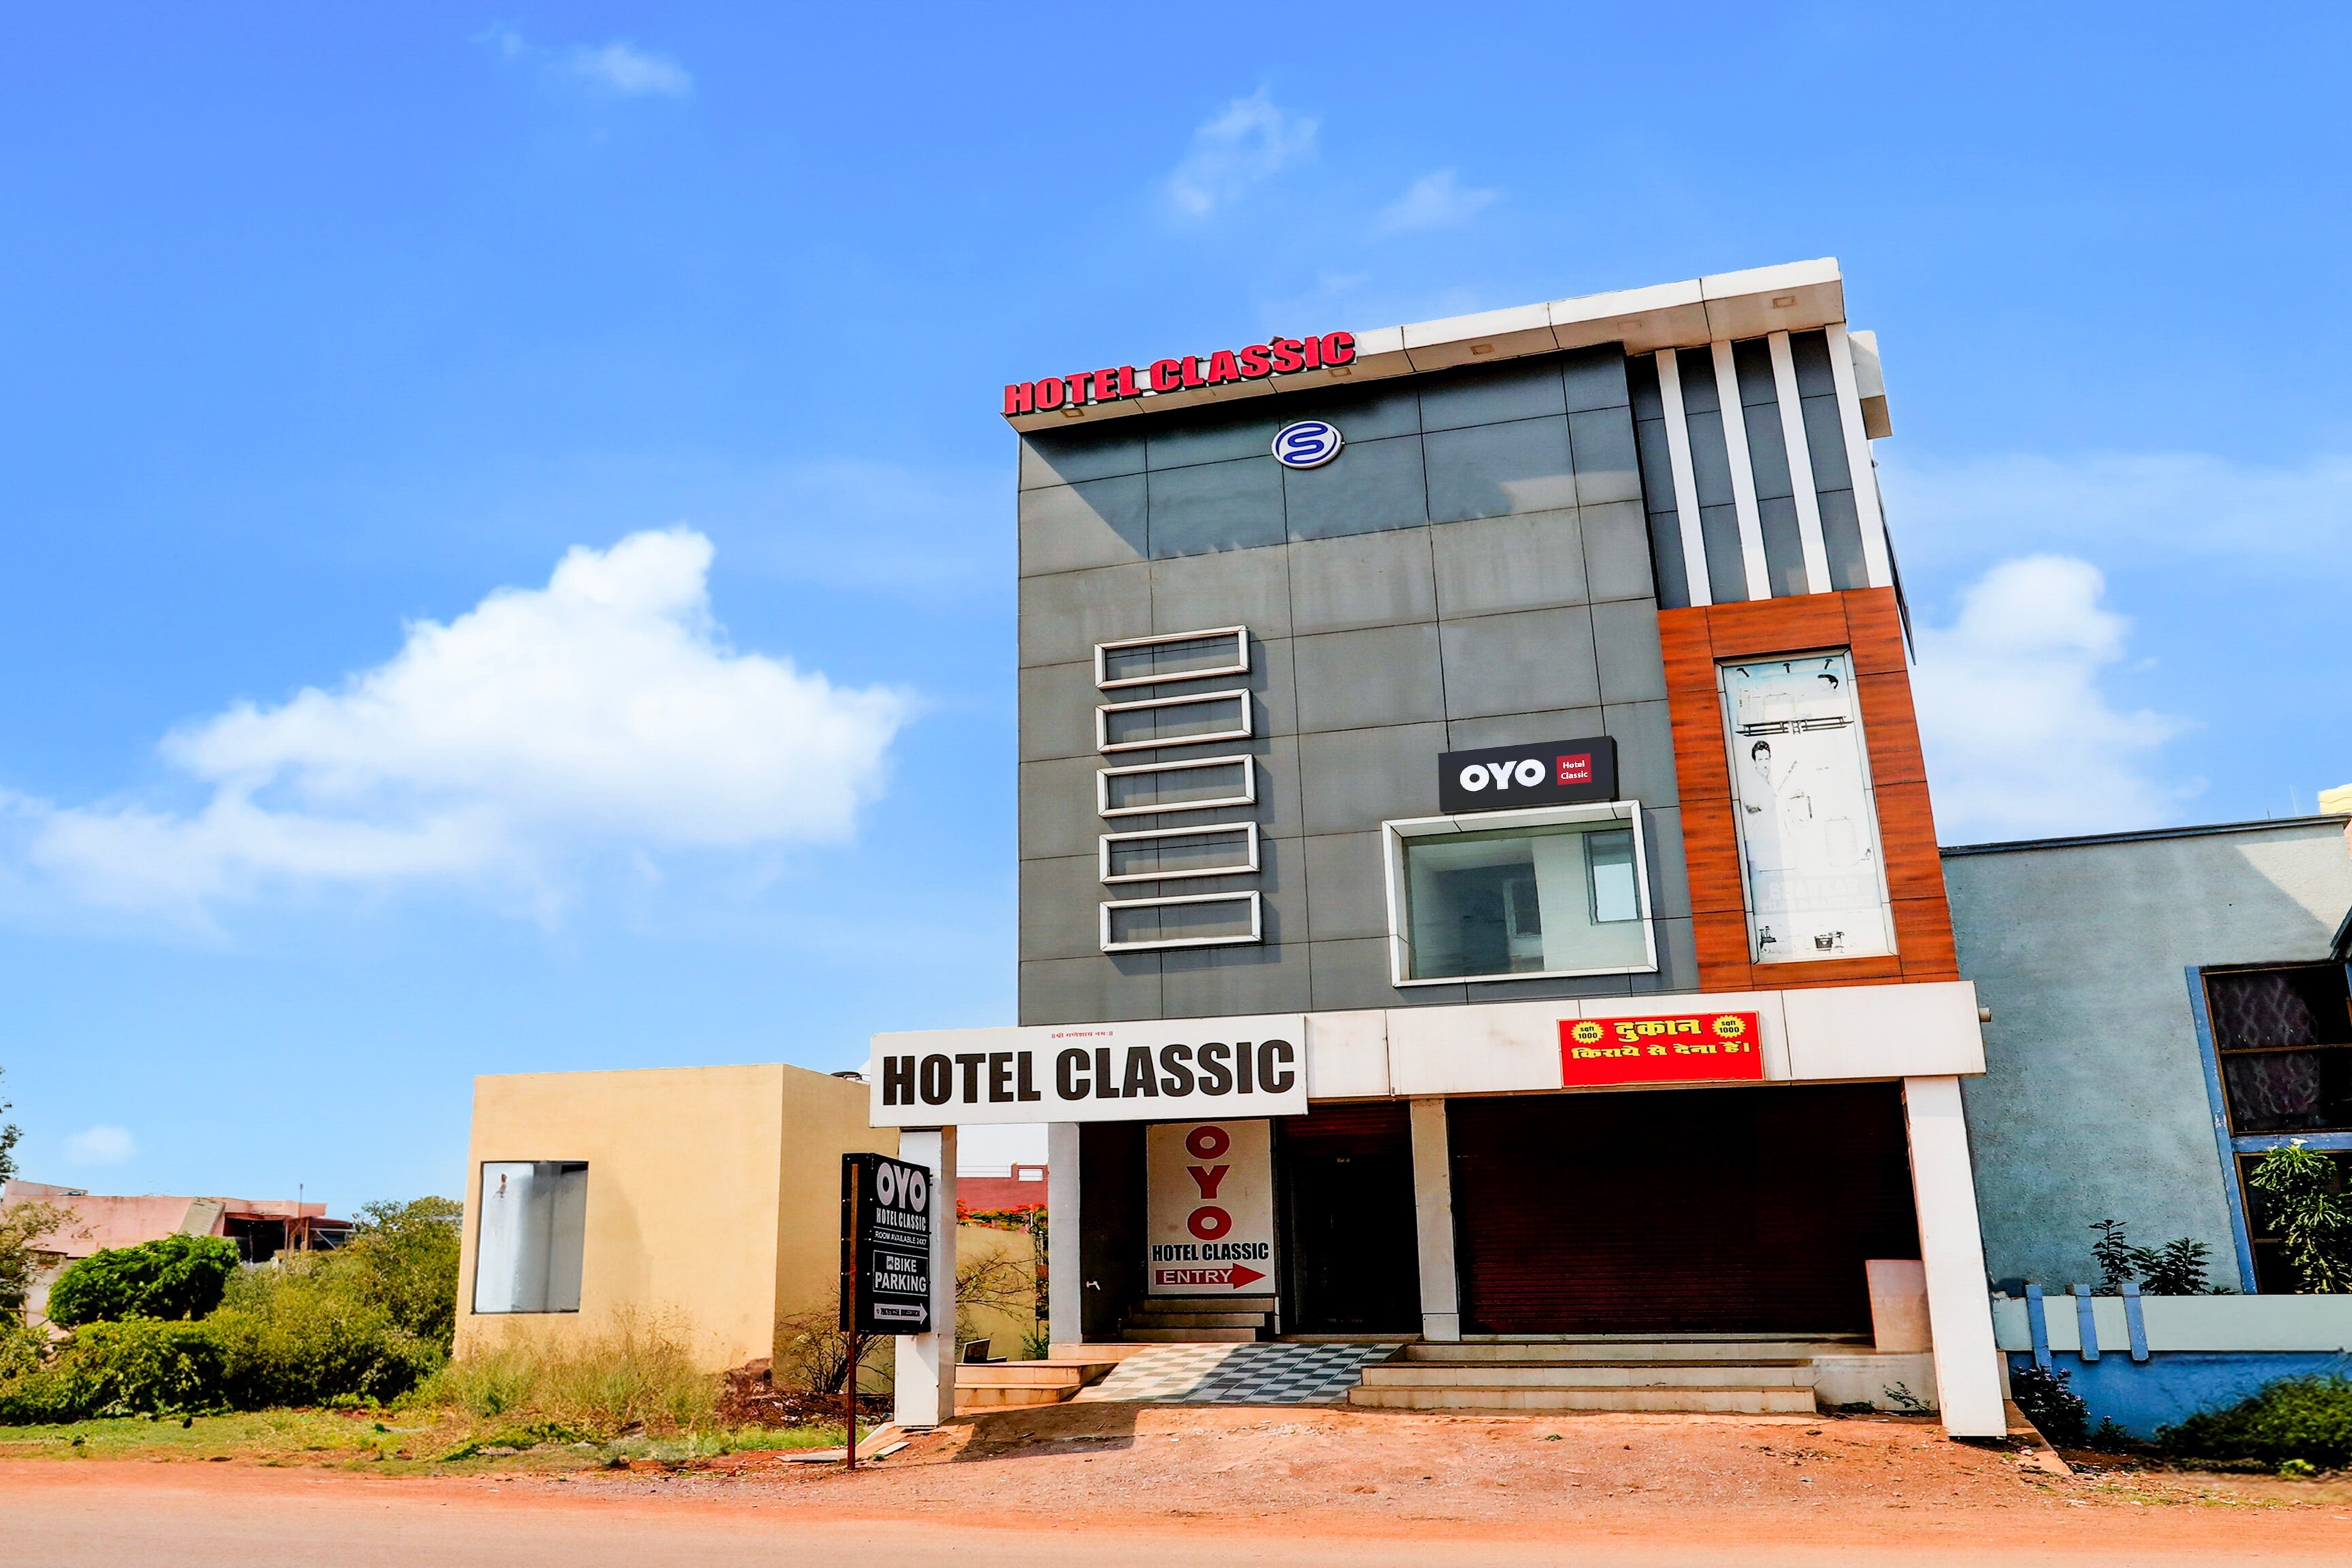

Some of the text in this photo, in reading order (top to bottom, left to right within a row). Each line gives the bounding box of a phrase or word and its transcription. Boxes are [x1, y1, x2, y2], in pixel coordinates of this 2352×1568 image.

[1004, 331, 1356, 415] HOTEL CLASSIC
[1561, 770, 1588, 779] Classic
[1563, 760, 1585, 769] Hotel
[1460, 759, 1546, 791] OYO
[1614, 1019, 1702, 1042] दुकान
[1571, 1045, 1641, 1059] किराये
[1646, 1044, 1667, 1056] से
[1673, 1043, 1718, 1054] देना
[883, 1039, 1294, 1106] HOTEL CLASSIC
[877, 1162, 926, 1212] OYO
[877, 1207, 926, 1232] HOTEL CLASSIC
[875, 1230, 890, 1239] ROOM
[891, 1233, 916, 1245] AVAILABLE
[1152, 1242, 1269, 1261] HOTEL CLASSIC
[894, 1257, 917, 1273] BIKE
[875, 1271, 926, 1292] PARKING
[1163, 1269, 1233, 1284] ENTRY
